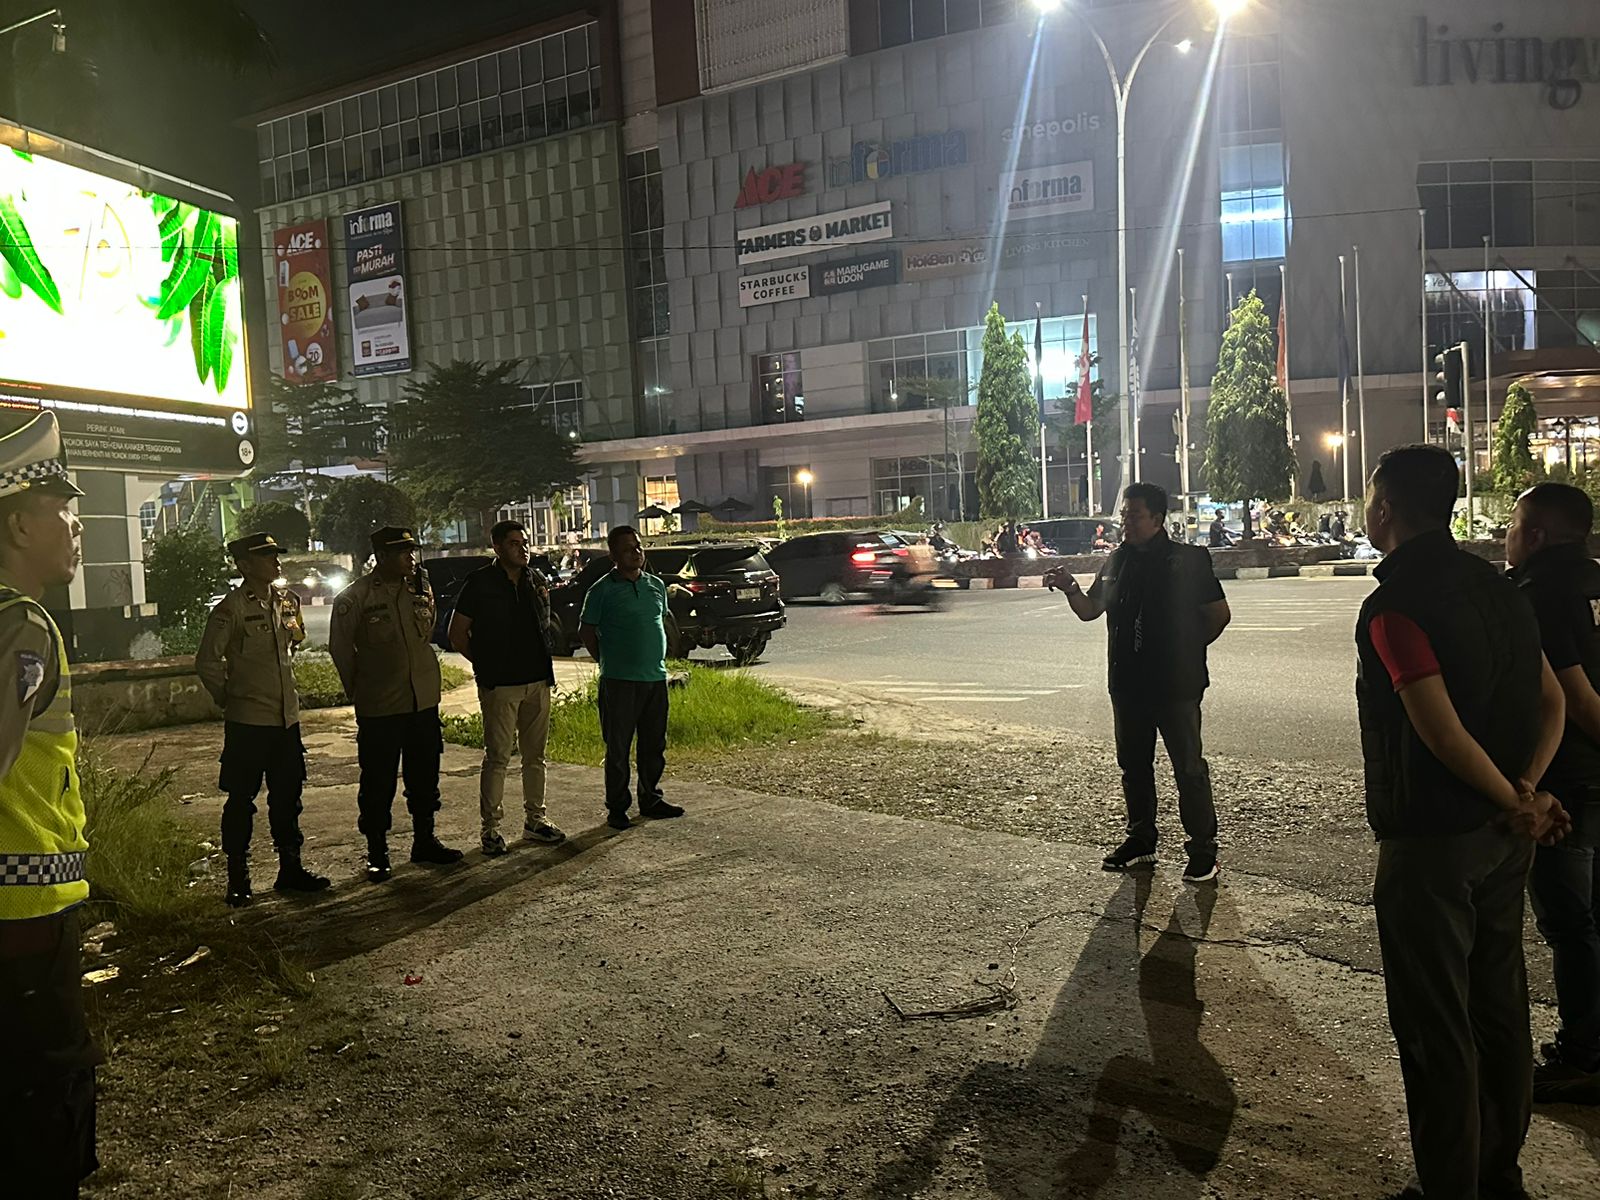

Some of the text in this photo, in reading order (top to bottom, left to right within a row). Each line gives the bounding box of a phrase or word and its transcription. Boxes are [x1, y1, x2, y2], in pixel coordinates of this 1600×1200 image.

[734, 162, 806, 208] ACE
[1005, 174, 1082, 203] nforma
[349, 211, 393, 236] informa
[737, 210, 892, 256] FARMERS MARKET
[286, 231, 315, 254] ACE
[356, 244, 383, 263] PASTI
[361, 253, 395, 274] MURAH
[906, 251, 955, 271] HokBen
[836, 259, 889, 276] MARUGAME
[740, 270, 807, 291] STARBUCKS
[836, 272, 864, 285] UDON
[288, 285, 319, 302] BOOM
[753, 285, 796, 300] COFFEE
[289, 302, 320, 322] SALE
